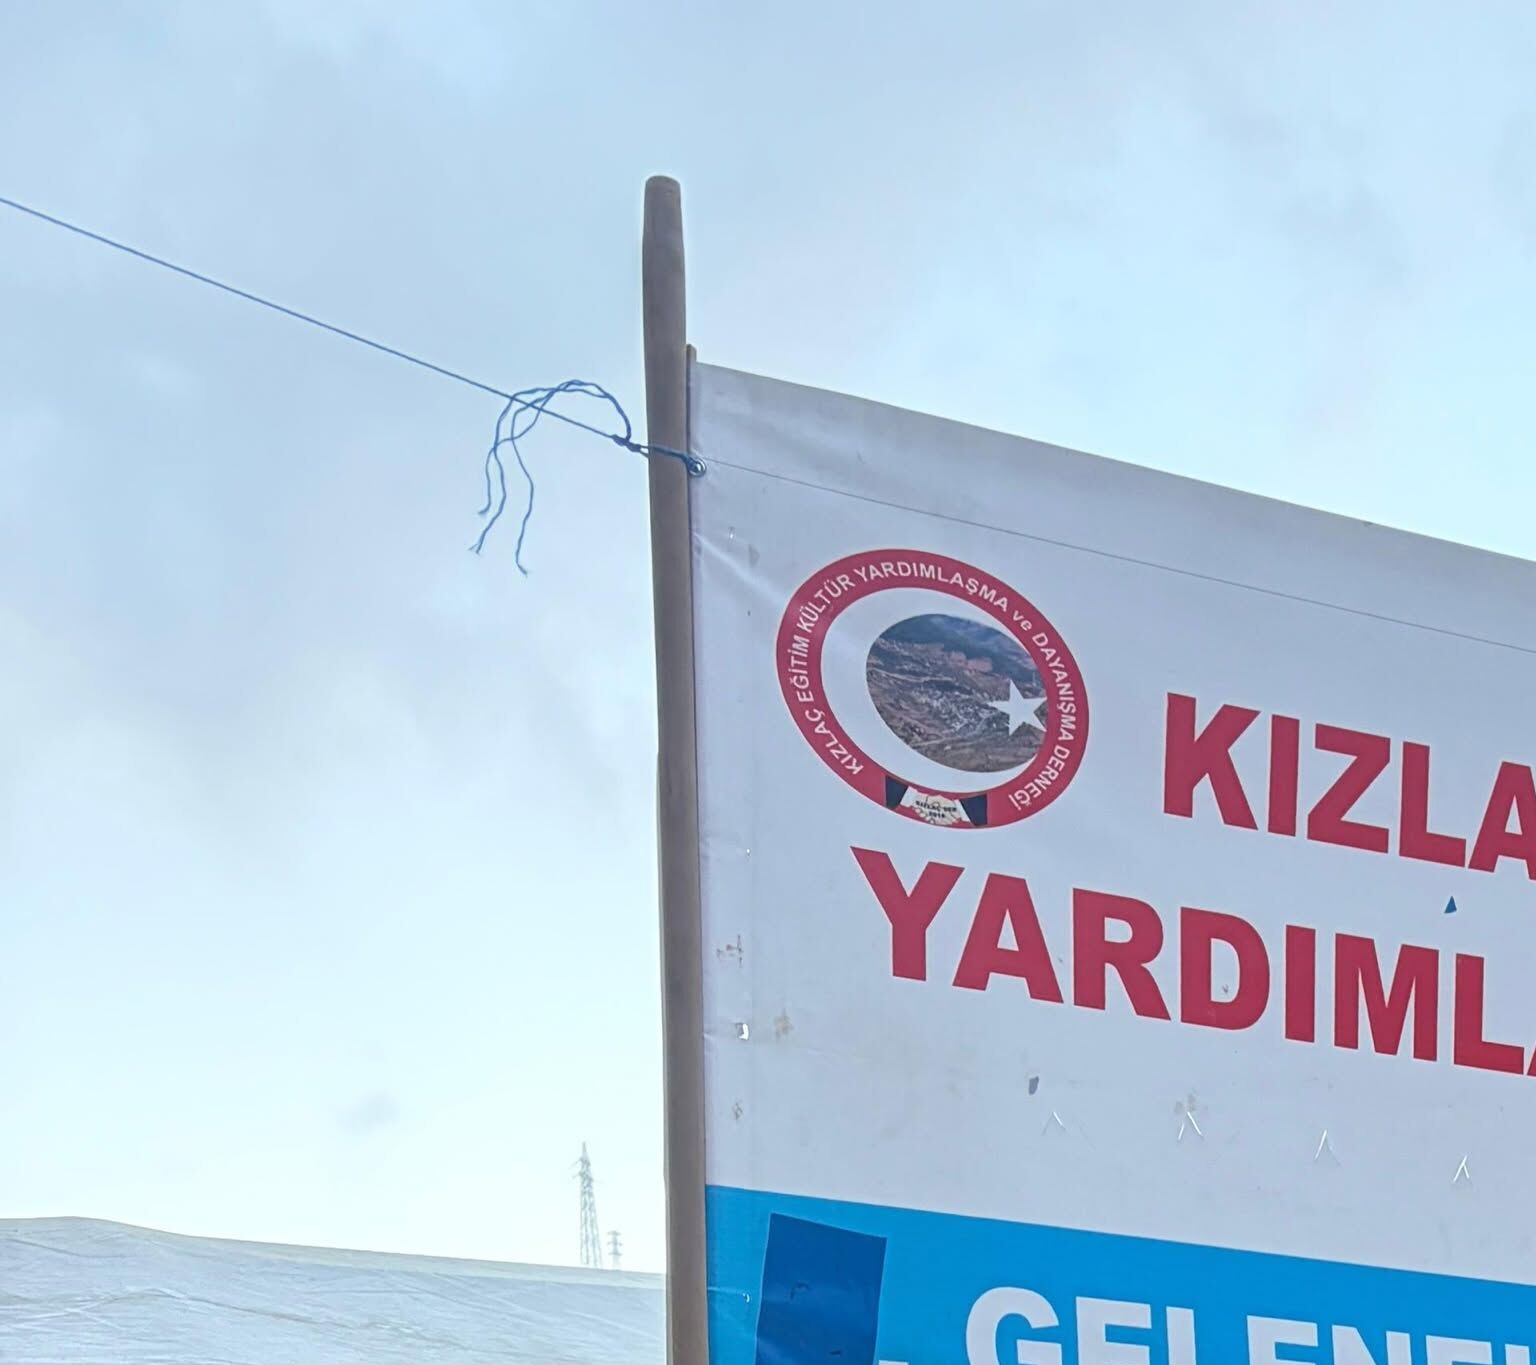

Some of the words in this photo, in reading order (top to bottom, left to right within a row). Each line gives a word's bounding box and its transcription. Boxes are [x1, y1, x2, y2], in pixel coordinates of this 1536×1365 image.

[796, 574, 856, 633] KÜLTÜR
[853, 561, 1008, 612] YARDIMLAŞMA
[1012, 609, 1033, 632] ve
[787, 634, 814, 703] EĞİTİM
[1031, 632, 1077, 742] DAYANIŞMA
[804, 708, 864, 776] KIZLAÇ
[1008, 746, 1071, 811] DERNEĞİ
